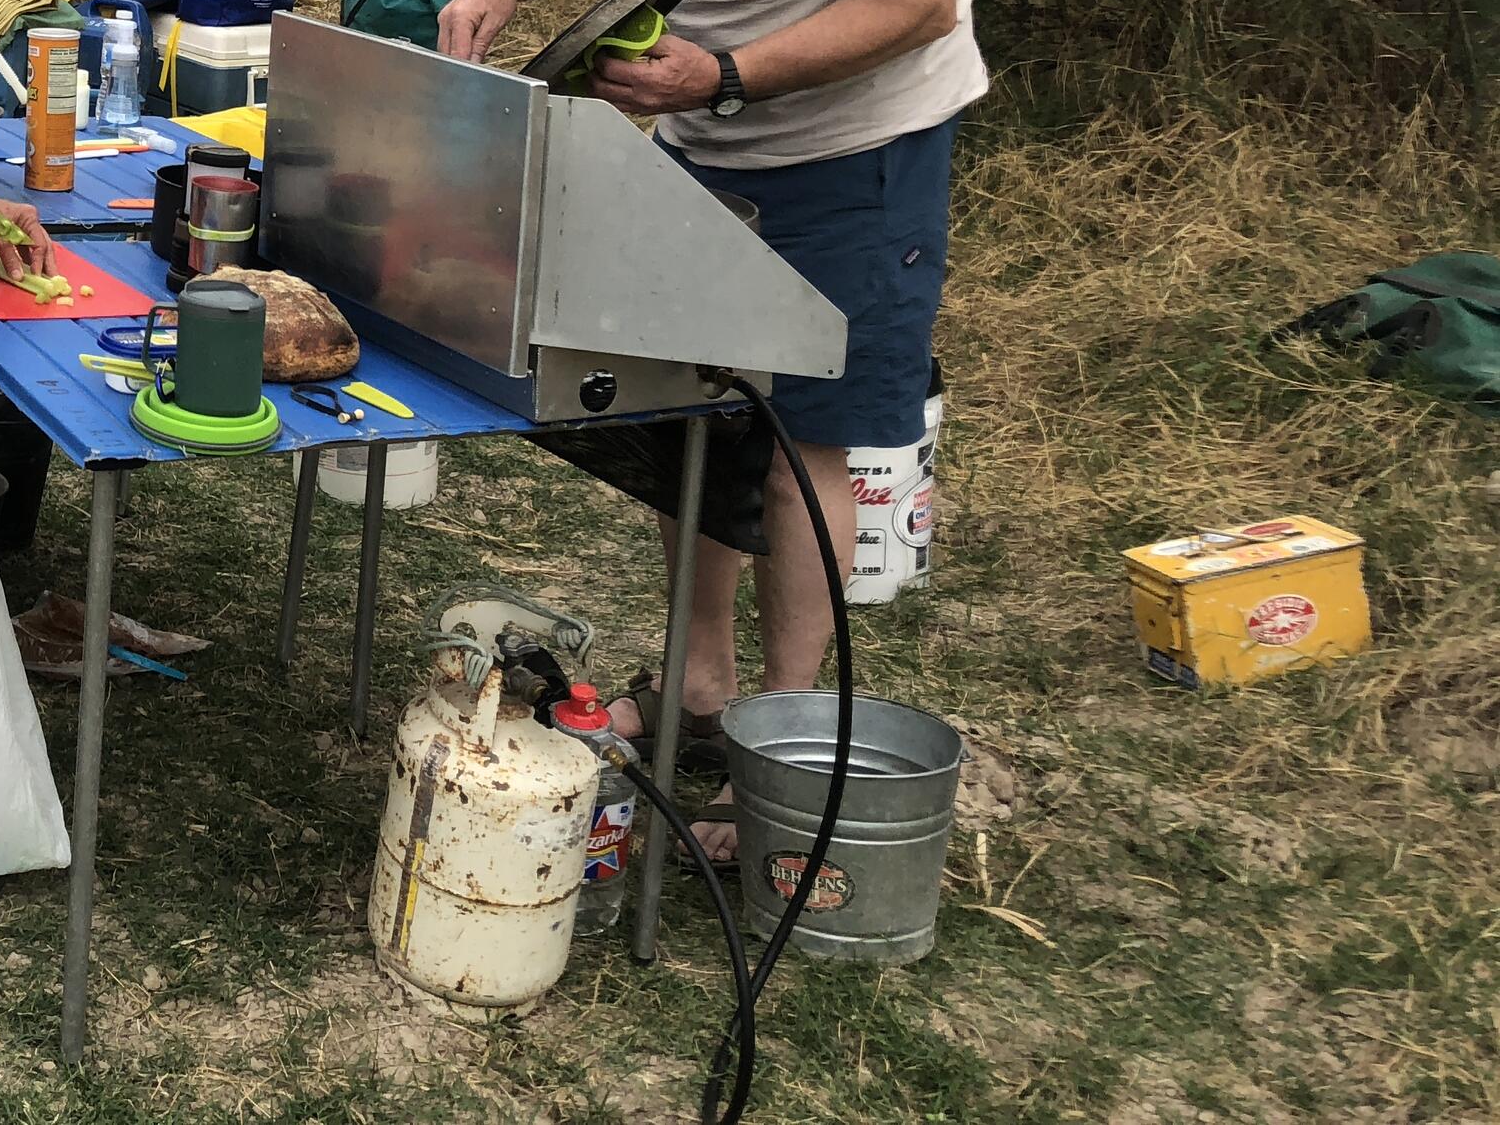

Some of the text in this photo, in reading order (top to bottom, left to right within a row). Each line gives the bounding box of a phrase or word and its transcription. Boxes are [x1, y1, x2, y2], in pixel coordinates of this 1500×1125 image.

[872, 467, 883, 475] IS
[884, 466, 892, 475] A
[855, 531, 881, 544] lue
[588, 829, 624, 849] zarka
[770, 863, 847, 893] BEHENS
